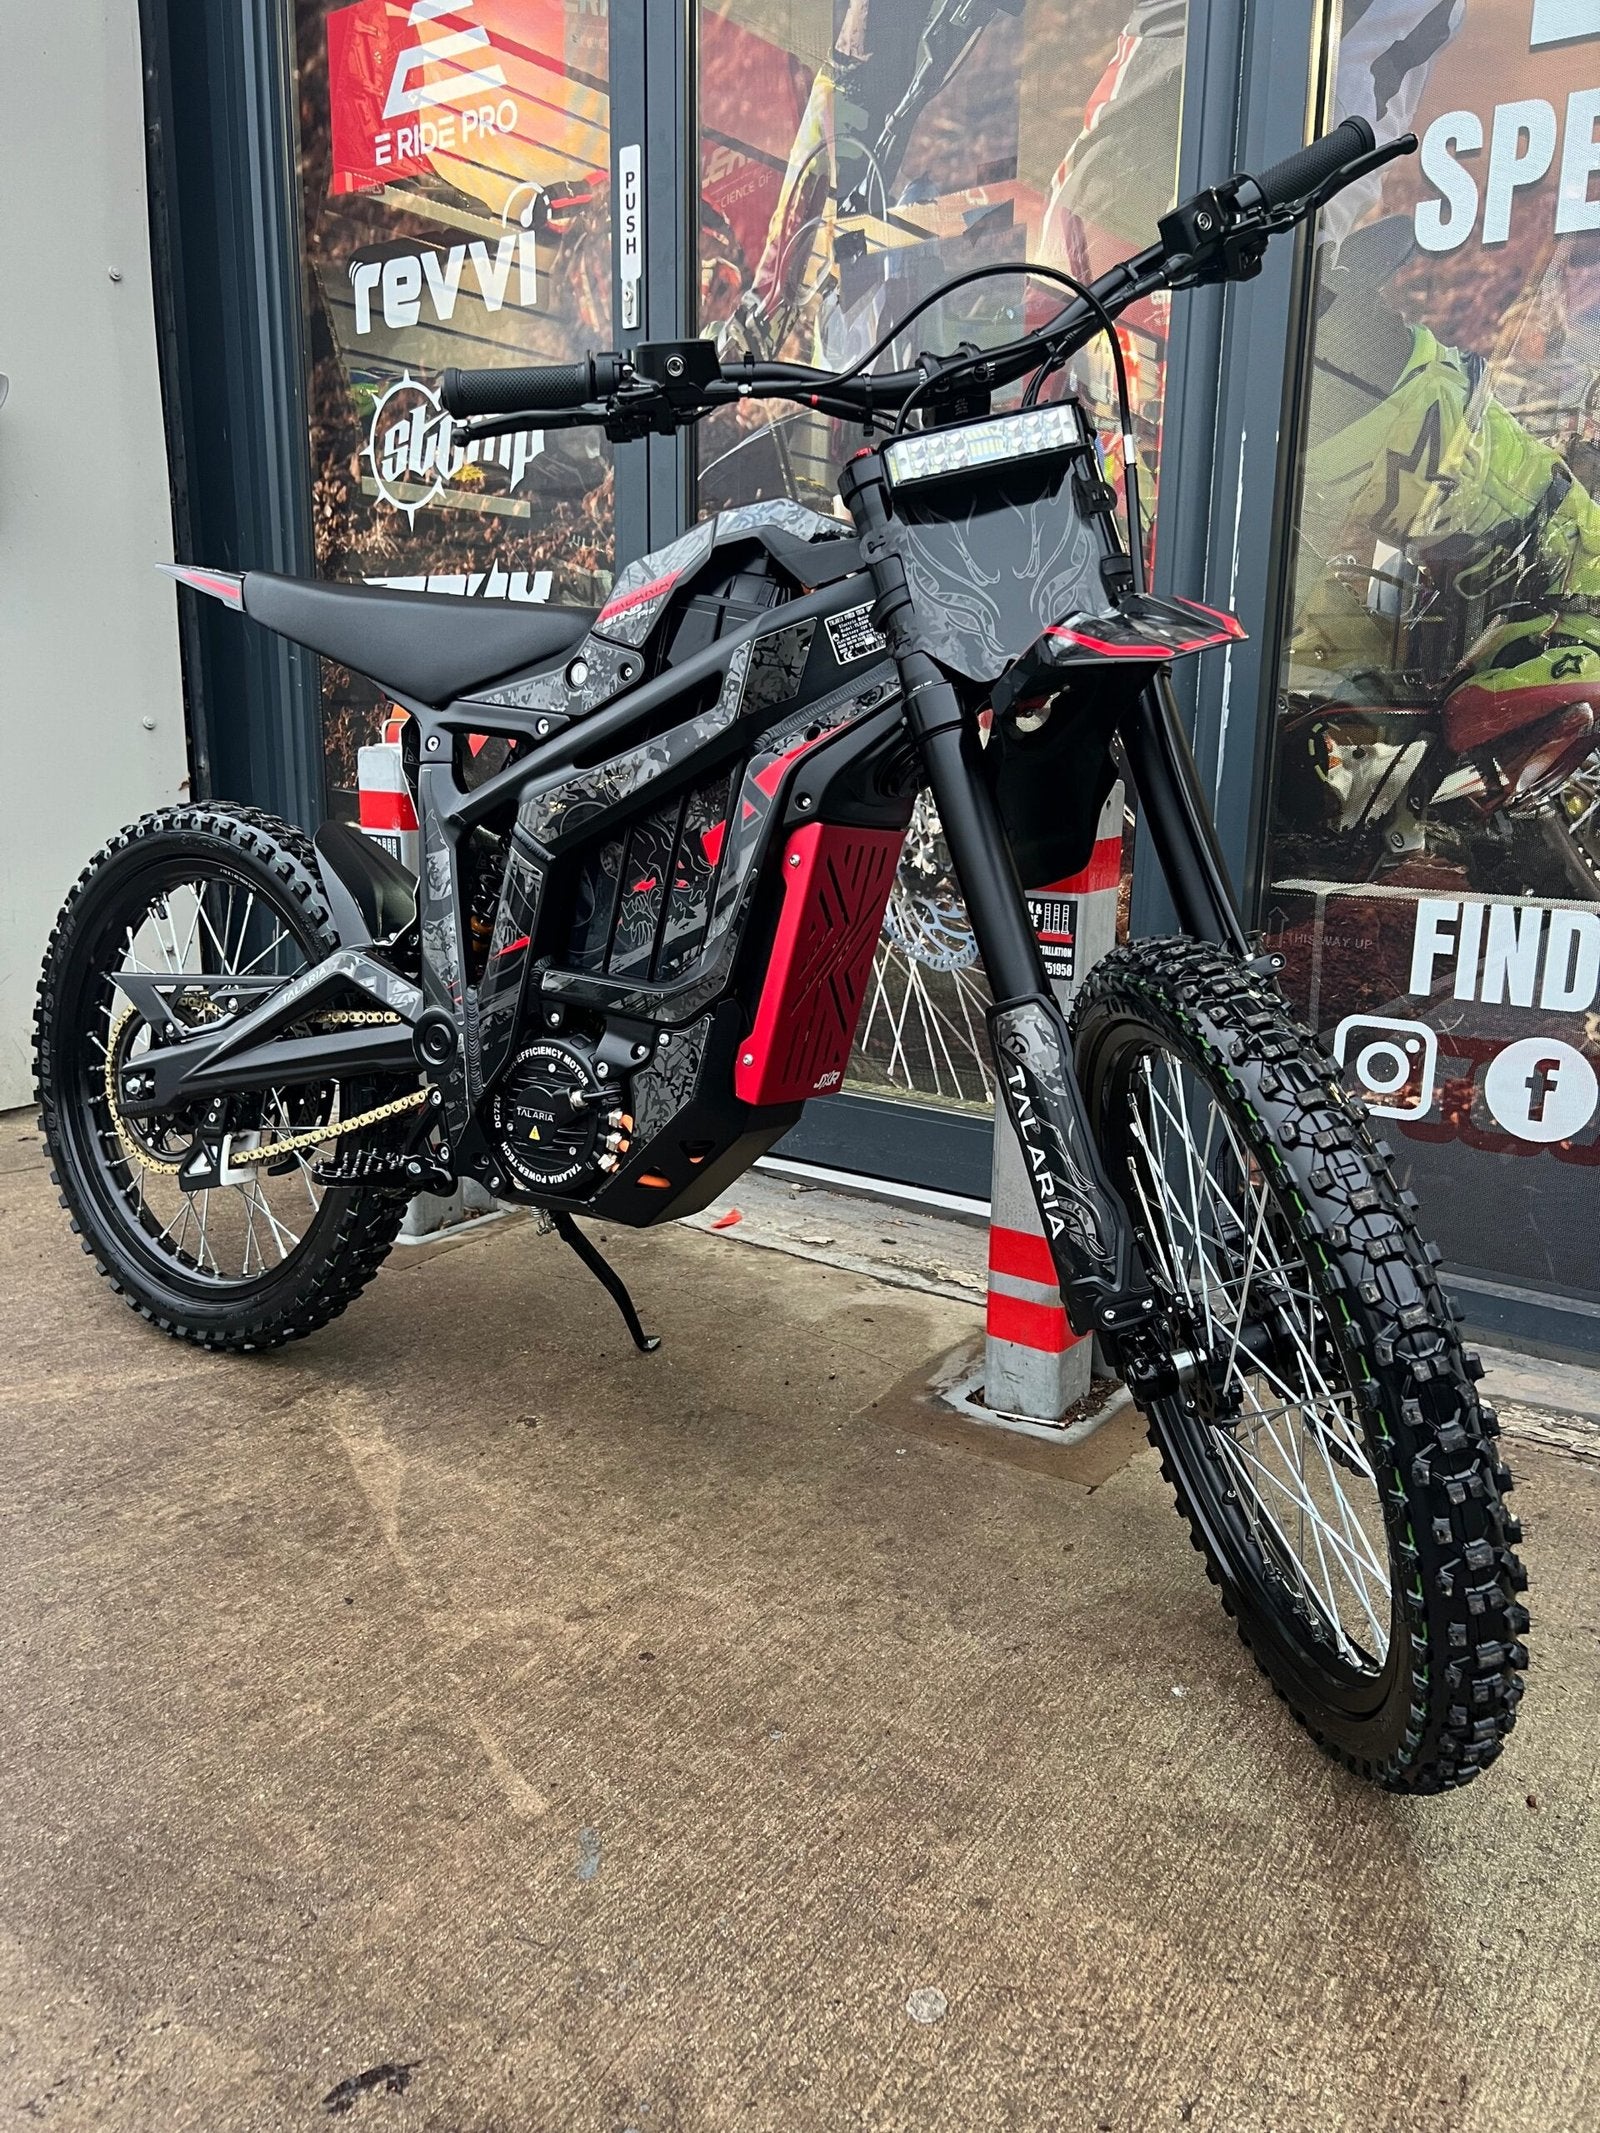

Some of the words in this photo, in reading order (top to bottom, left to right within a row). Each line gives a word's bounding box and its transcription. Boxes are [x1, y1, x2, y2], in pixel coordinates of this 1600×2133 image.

[374, 132, 392, 166] E
[397, 115, 455, 160] RIDE
[462, 98, 518, 144] PRO
[719, 181, 755, 208] CIENCE
[625, 171, 637, 255] PUSH
[348, 228, 538, 334] revvi
[602, 604, 643, 628] STING
[1040, 945, 1072, 958] TALLATION
[1287, 932, 1314, 945] THIS
[1322, 936, 1351, 948] WAY
[1355, 939, 1373, 949] UP
[1409, 899, 1600, 1013] FIND
[282, 966, 327, 1004] TALARIA
[563, 1055, 590, 1086] MOTOR
[493, 1094, 502, 1129] DC72V
[516, 1106, 554, 1122] TALARIA
[500, 1141, 547, 1184] POWER-TECH
[1008, 1065, 1067, 1240] TALARIA
[549, 1162, 582, 1184] TALARIA
